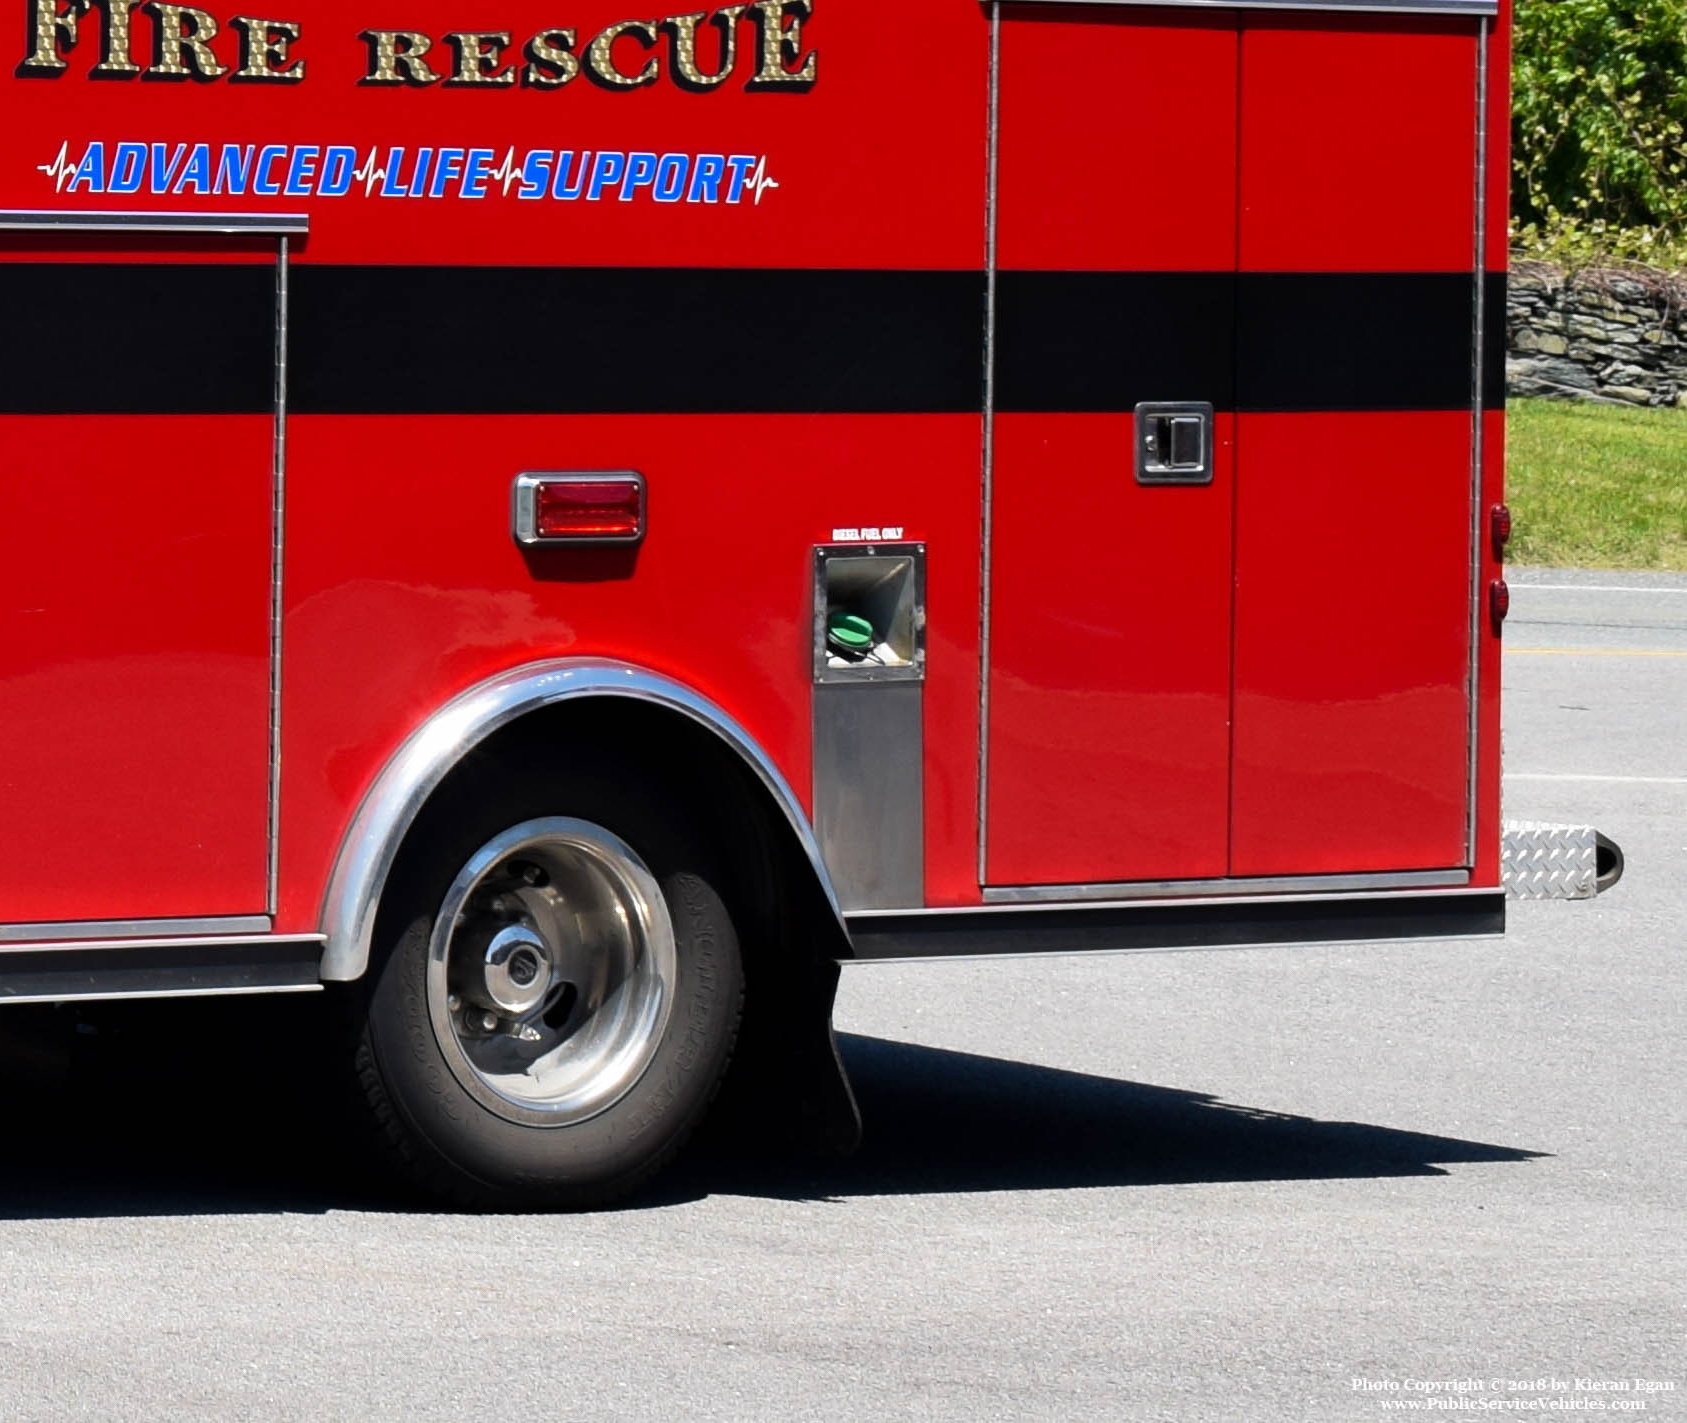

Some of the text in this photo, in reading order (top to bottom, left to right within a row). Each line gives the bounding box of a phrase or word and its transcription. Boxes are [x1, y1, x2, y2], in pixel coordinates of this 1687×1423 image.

[72, 140, 755, 203] ADVANCED LIFE SUPPORT
